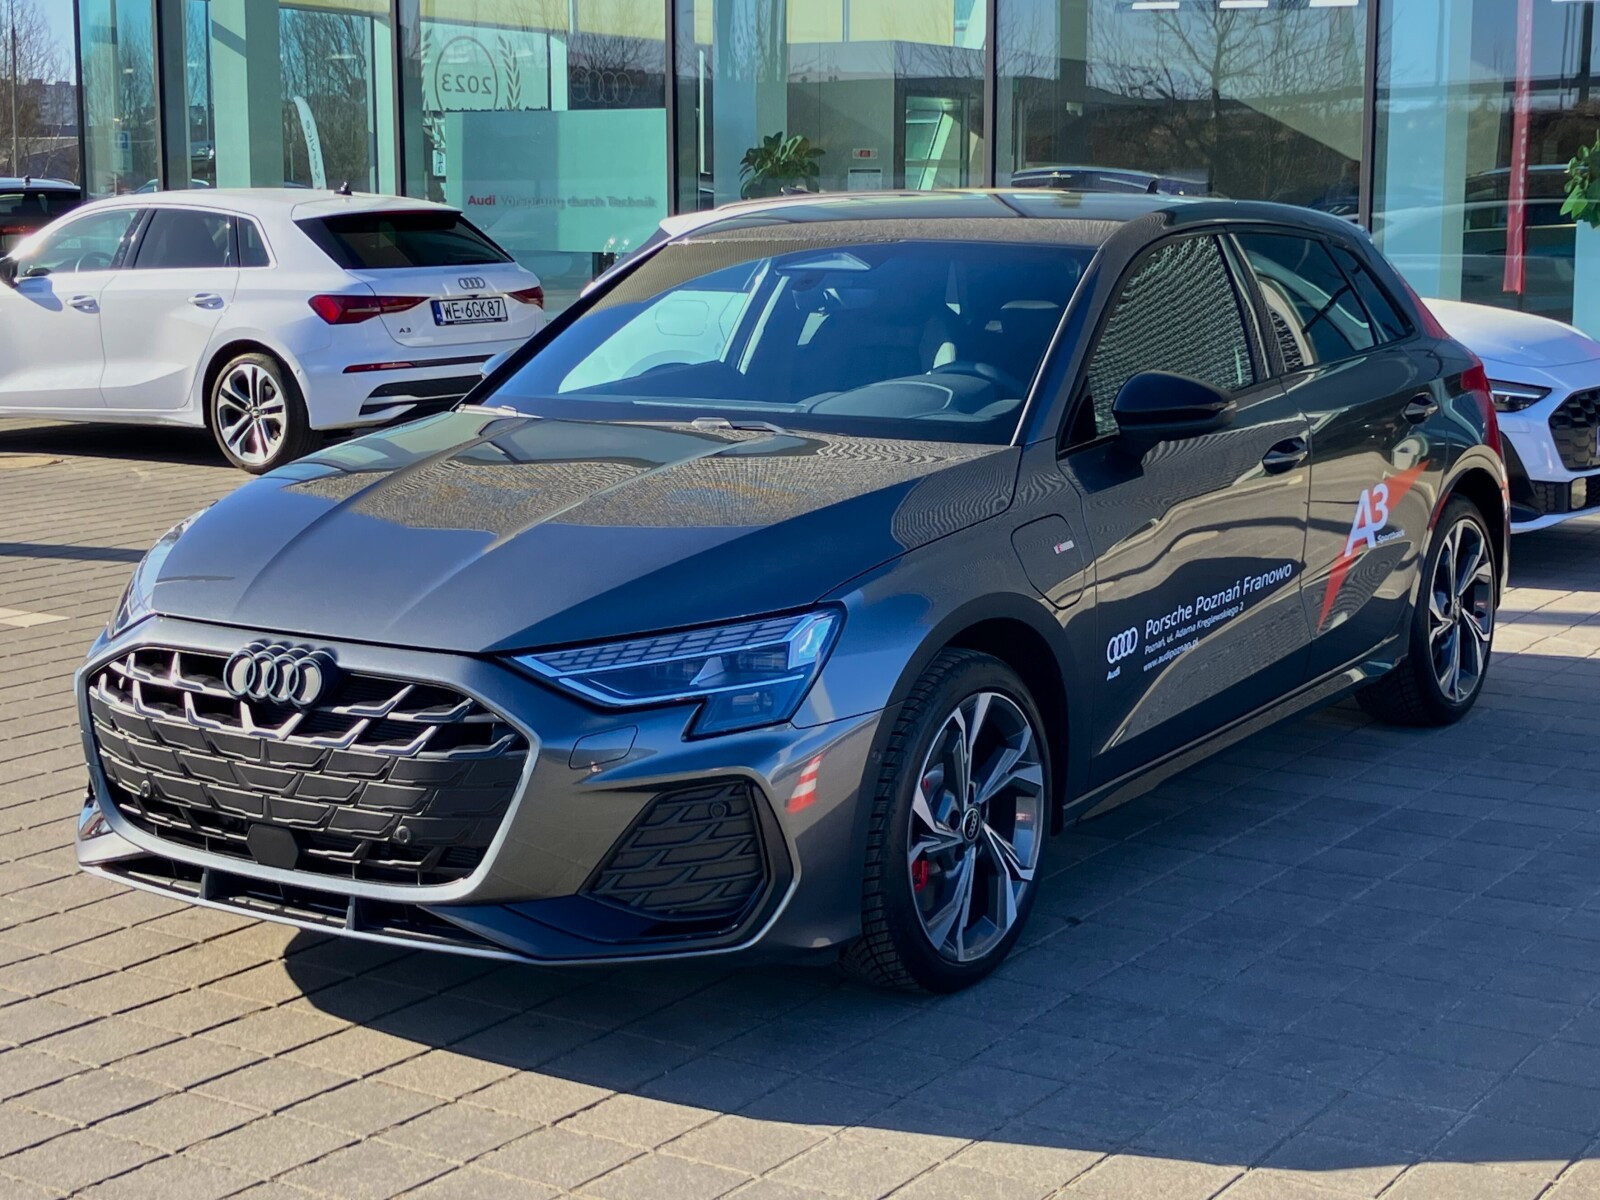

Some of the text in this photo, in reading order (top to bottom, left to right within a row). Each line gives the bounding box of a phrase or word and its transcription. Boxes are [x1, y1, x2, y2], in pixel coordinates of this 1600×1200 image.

[468, 195, 496, 206] Audi
[443, 300, 501, 320] WE 6GK87
[1343, 483, 1389, 558] A3
[1144, 563, 1292, 640] Porsche Poznań Franowo
[1239, 601, 1245, 612] 2
[1106, 666, 1121, 681] Audi
